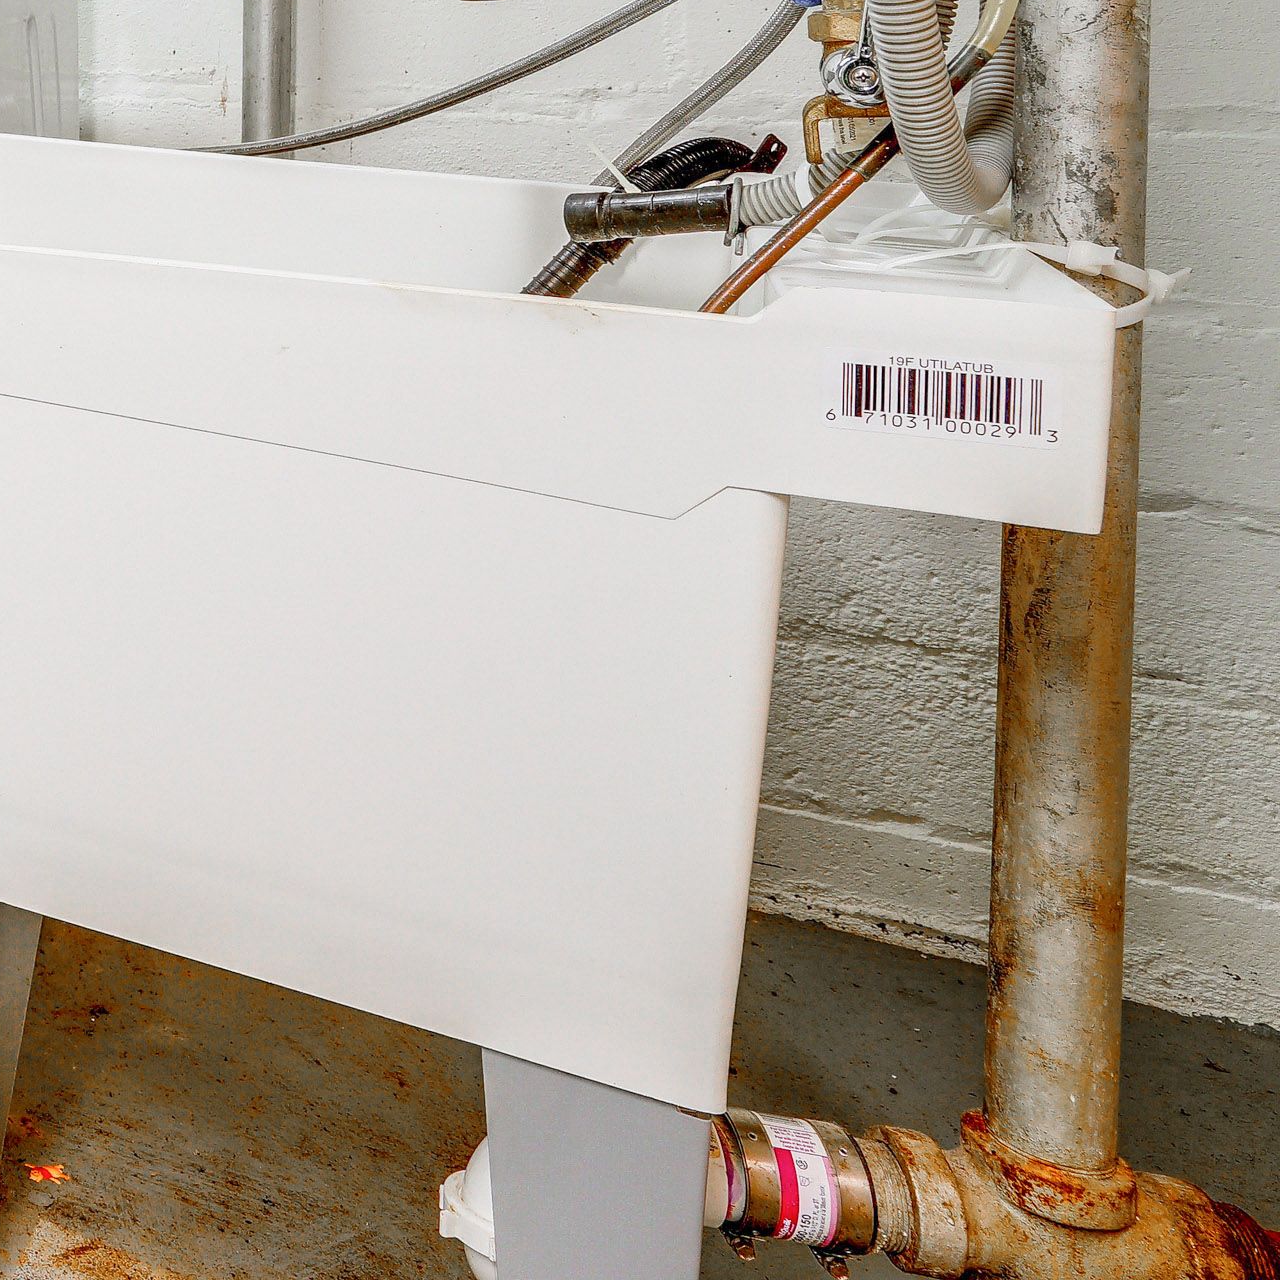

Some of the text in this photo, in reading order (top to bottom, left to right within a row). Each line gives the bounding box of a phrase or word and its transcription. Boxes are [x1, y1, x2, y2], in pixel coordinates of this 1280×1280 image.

[889, 356, 994, 374] 19F UTILATUB
[826, 408, 1058, 443] 6 71031 00029 3
